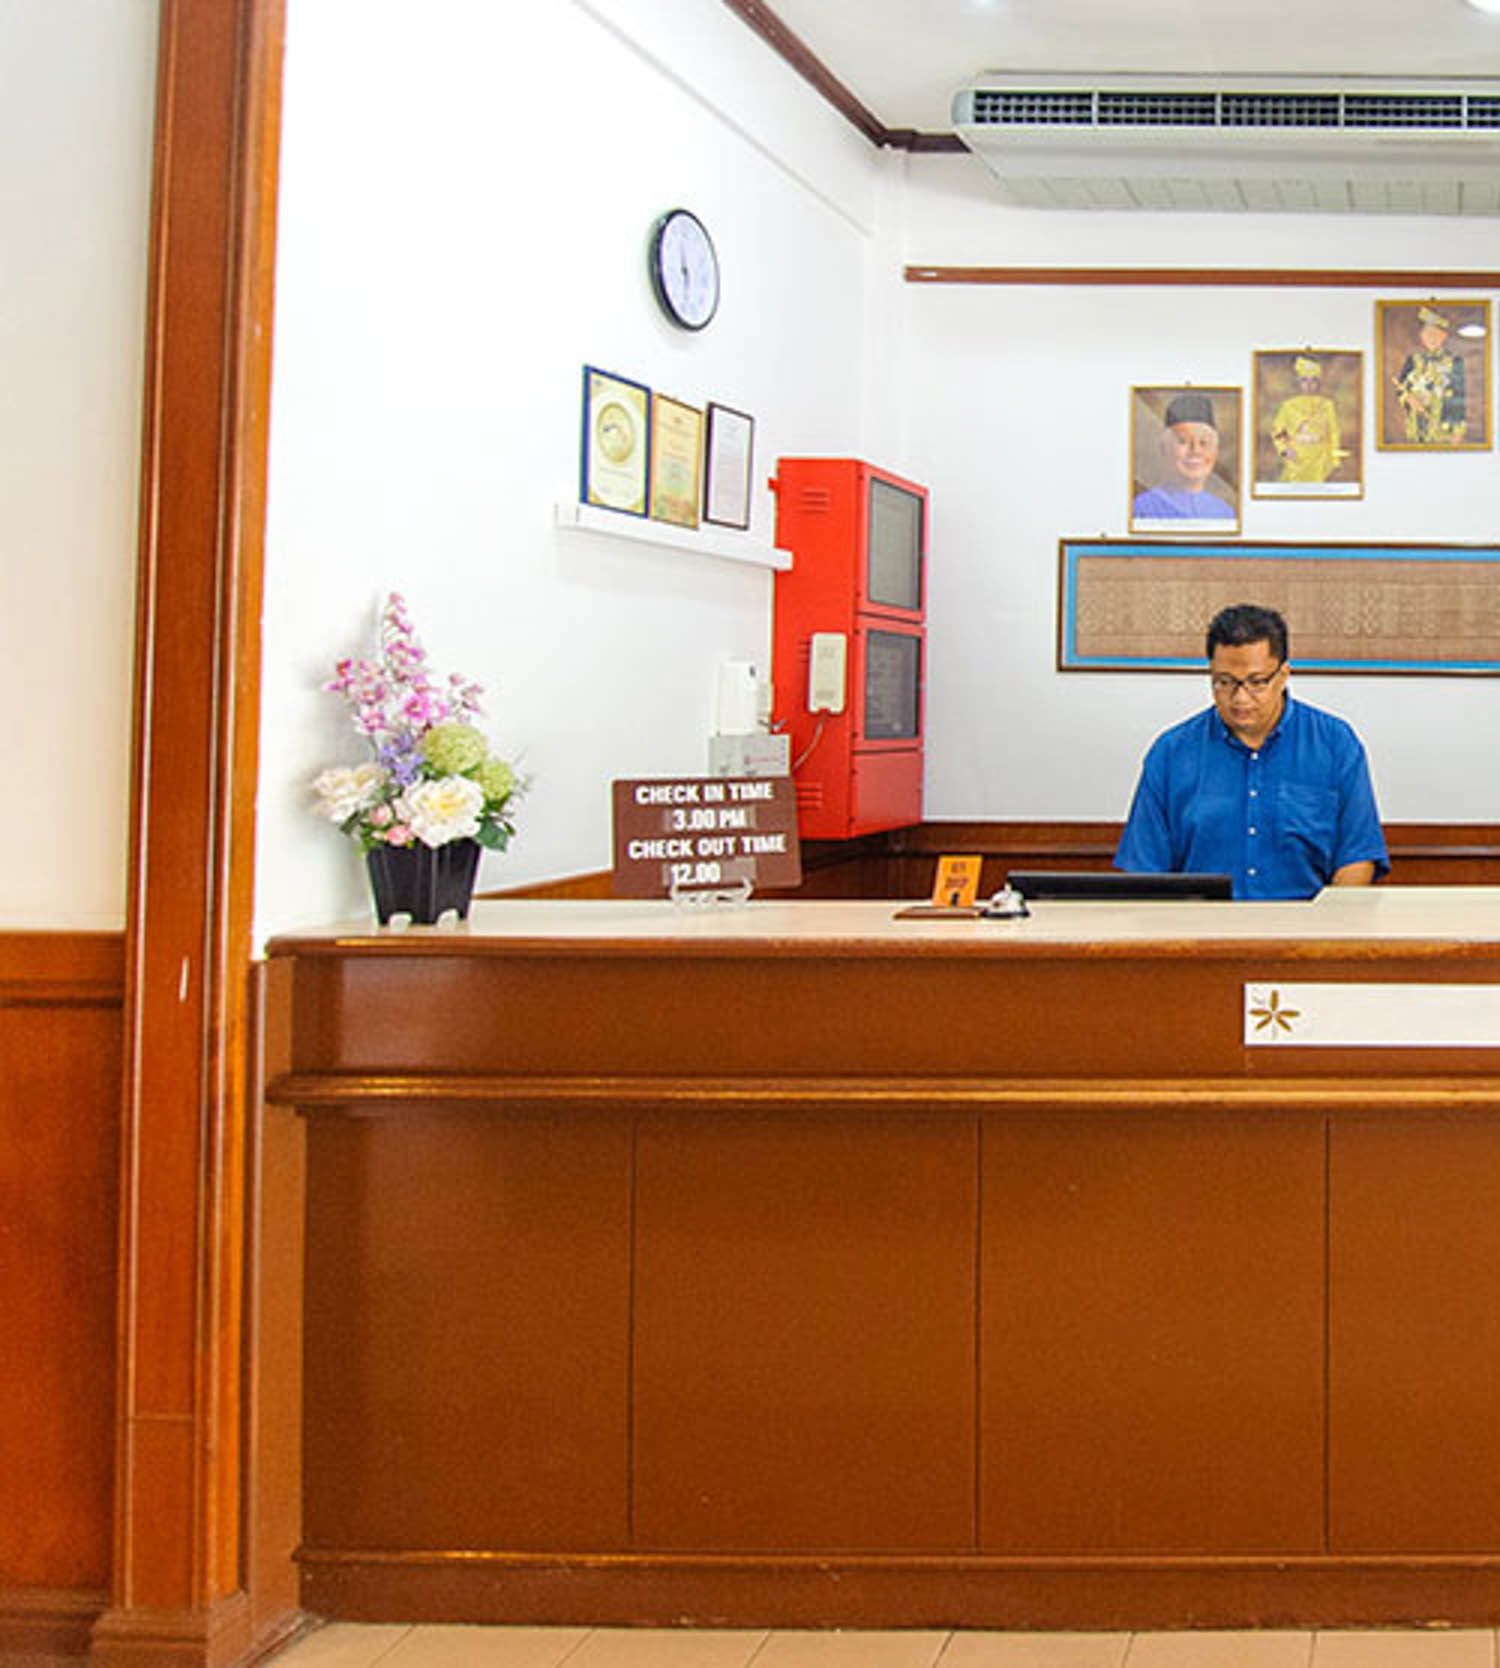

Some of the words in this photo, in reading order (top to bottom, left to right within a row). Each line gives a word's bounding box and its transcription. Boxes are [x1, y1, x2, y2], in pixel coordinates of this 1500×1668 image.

[635, 785, 700, 805] CHECK
[704, 784, 725, 802] IN
[729, 782, 774, 800] TIME
[672, 809, 715, 831] 3.00
[719, 809, 747, 829] PM
[628, 840, 693, 859] CHECK
[698, 838, 735, 857] OUT
[741, 835, 787, 854] TIME
[670, 863, 721, 885] 12.00
